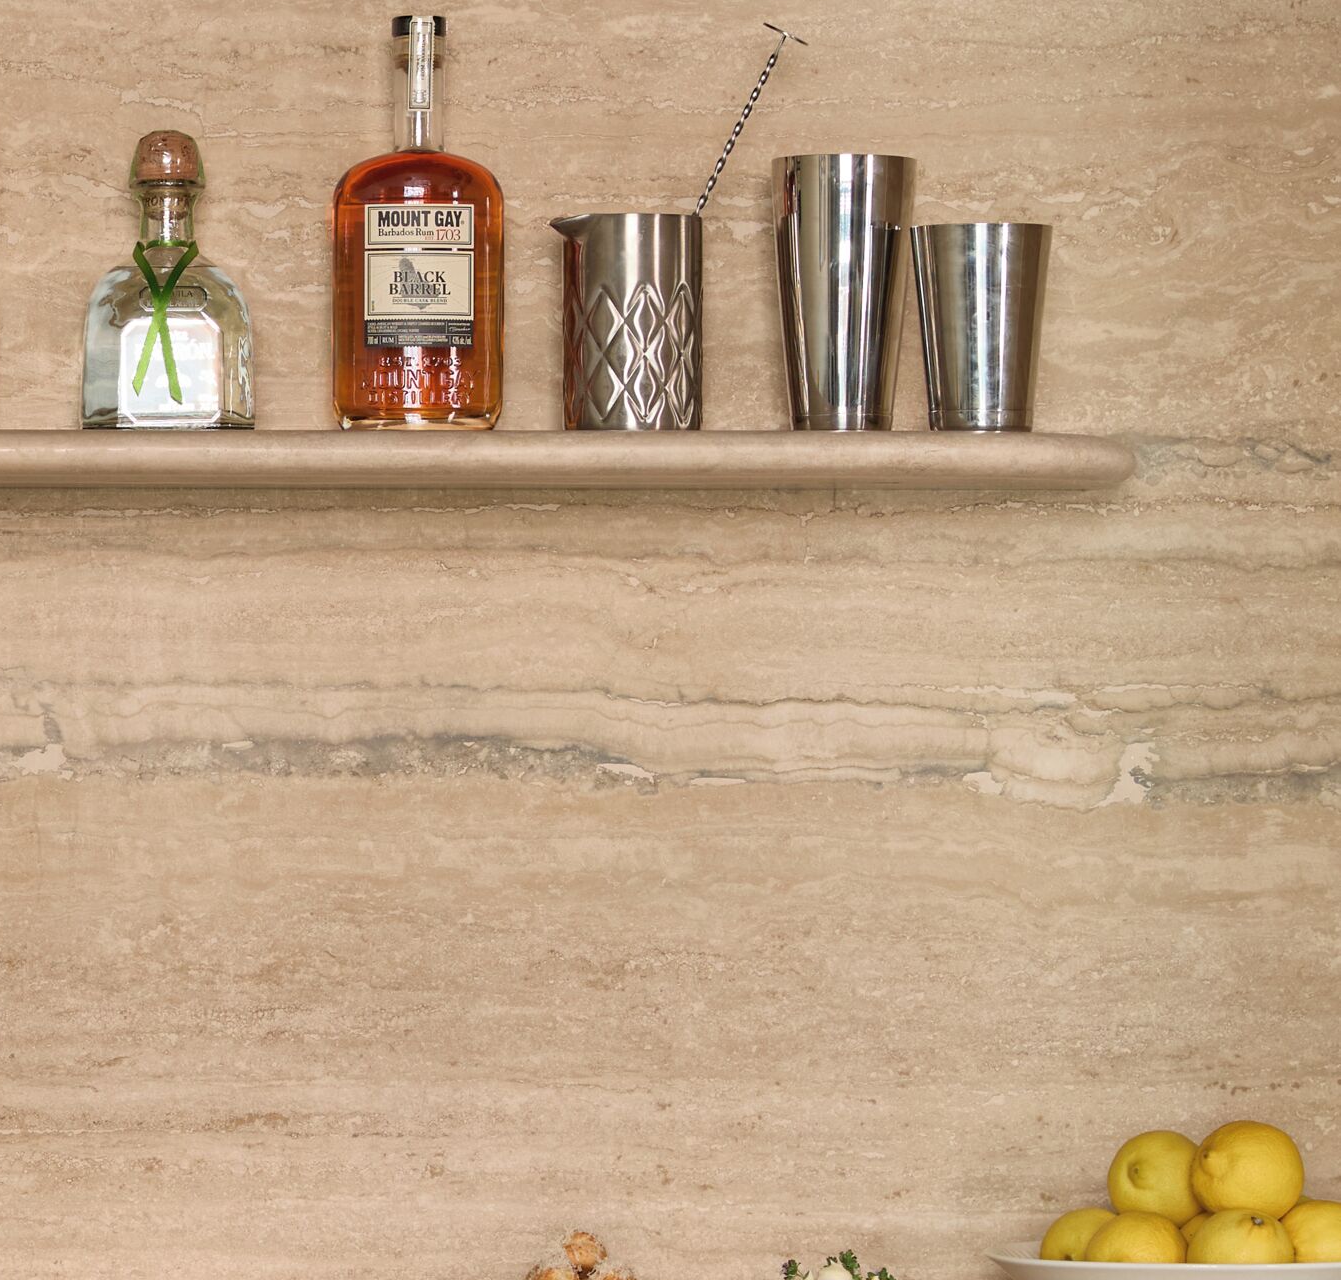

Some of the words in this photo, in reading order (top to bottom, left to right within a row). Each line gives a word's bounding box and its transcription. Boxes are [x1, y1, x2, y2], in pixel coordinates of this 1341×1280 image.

[378, 210, 431, 228] MOUNT
[435, 210, 463, 228] GAY
[378, 228, 415, 237] Barbados
[415, 228, 434, 237] Rum
[435, 229, 461, 241] 1703
[393, 271, 446, 283] BLACK
[389, 283, 451, 295] BARREL
[381, 336, 396, 344] RUM
[360, 369, 434, 389] MOUNT
[439, 369, 480, 389] GAY
